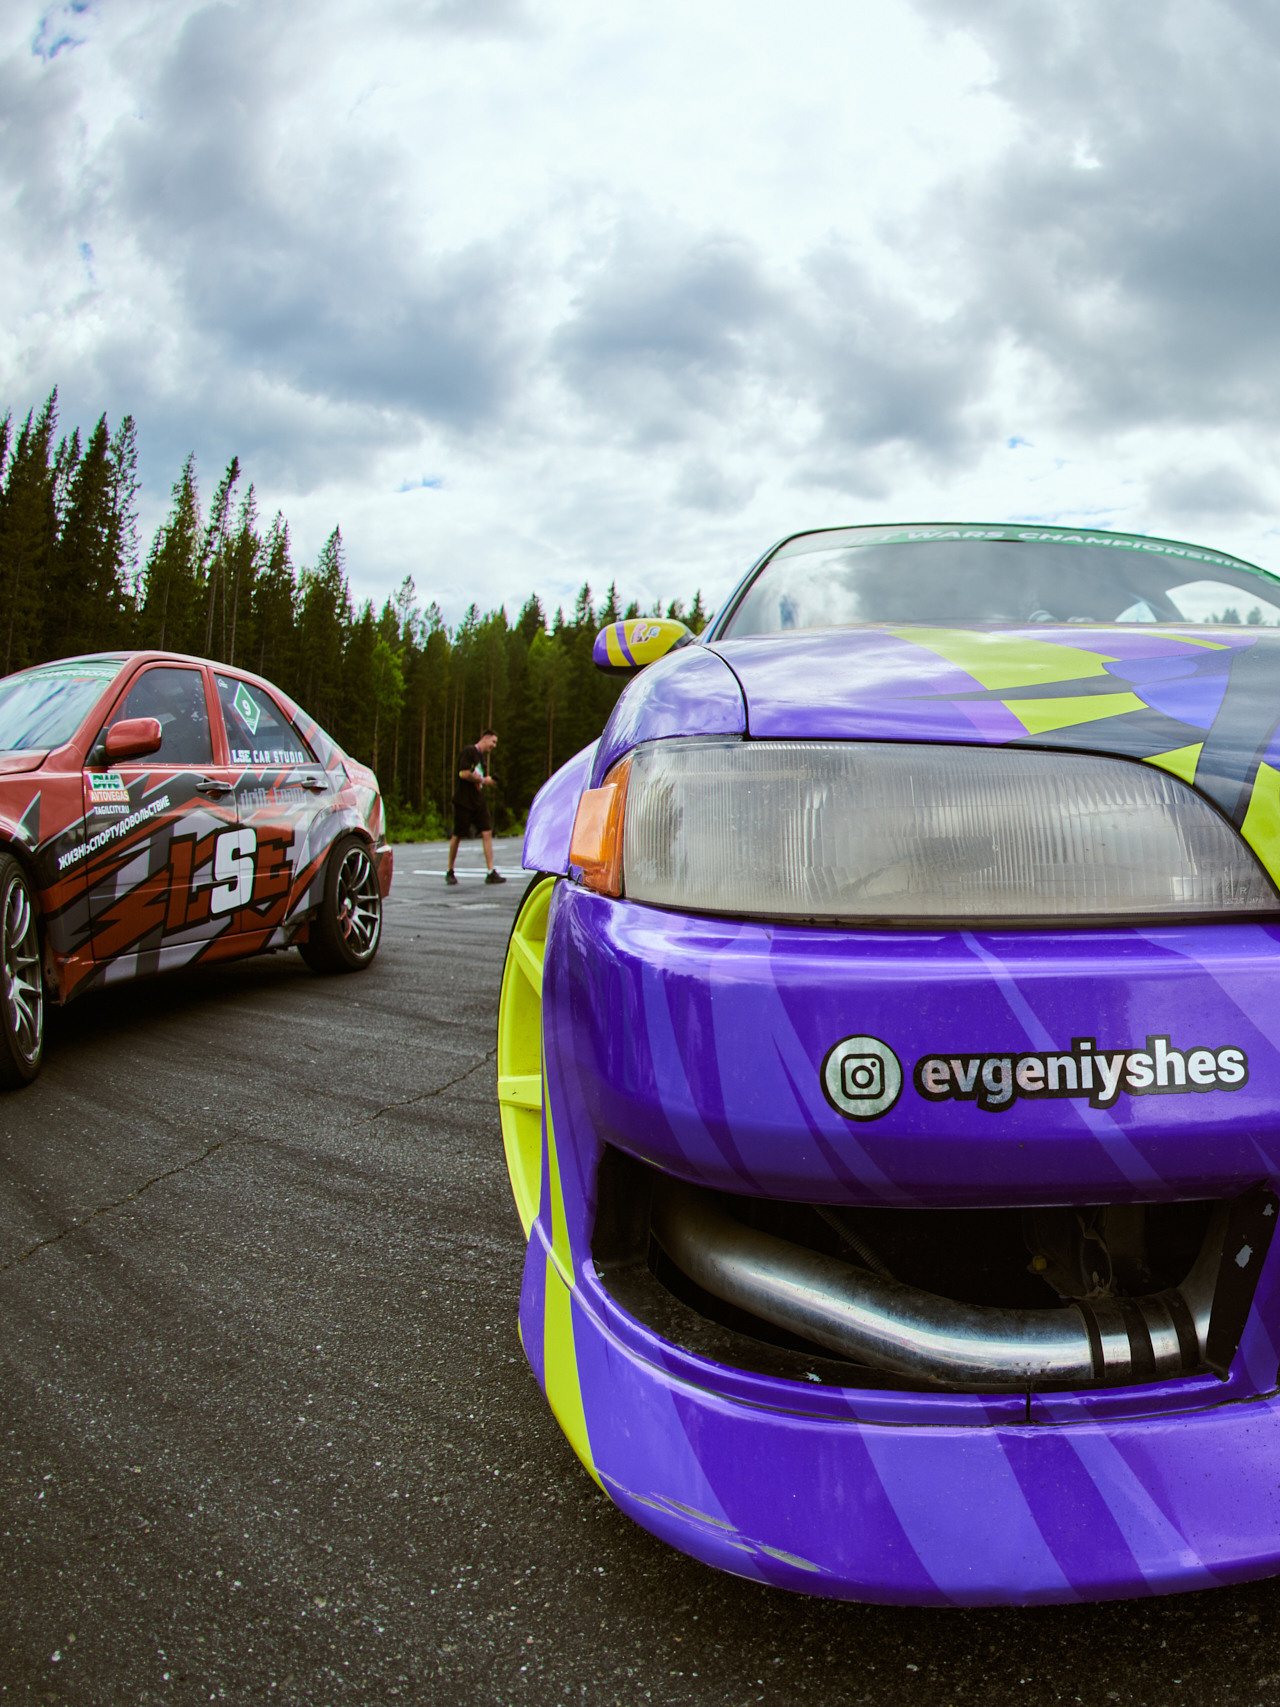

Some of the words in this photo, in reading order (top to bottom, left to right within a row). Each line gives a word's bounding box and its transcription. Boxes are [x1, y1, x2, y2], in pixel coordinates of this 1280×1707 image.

[907, 530, 1005, 541] WARS
[241, 699, 252, 716] 9
[231, 750, 252, 763] LSE
[253, 750, 271, 763] CAR
[274, 751, 304, 763] STUDIO
[91, 791, 130, 801] AVTOVEGAS
[240, 787, 271, 810] drift
[94, 804, 130, 815] TAGILCITY.RU
[920, 1038, 1247, 1105] evgeniyshes
